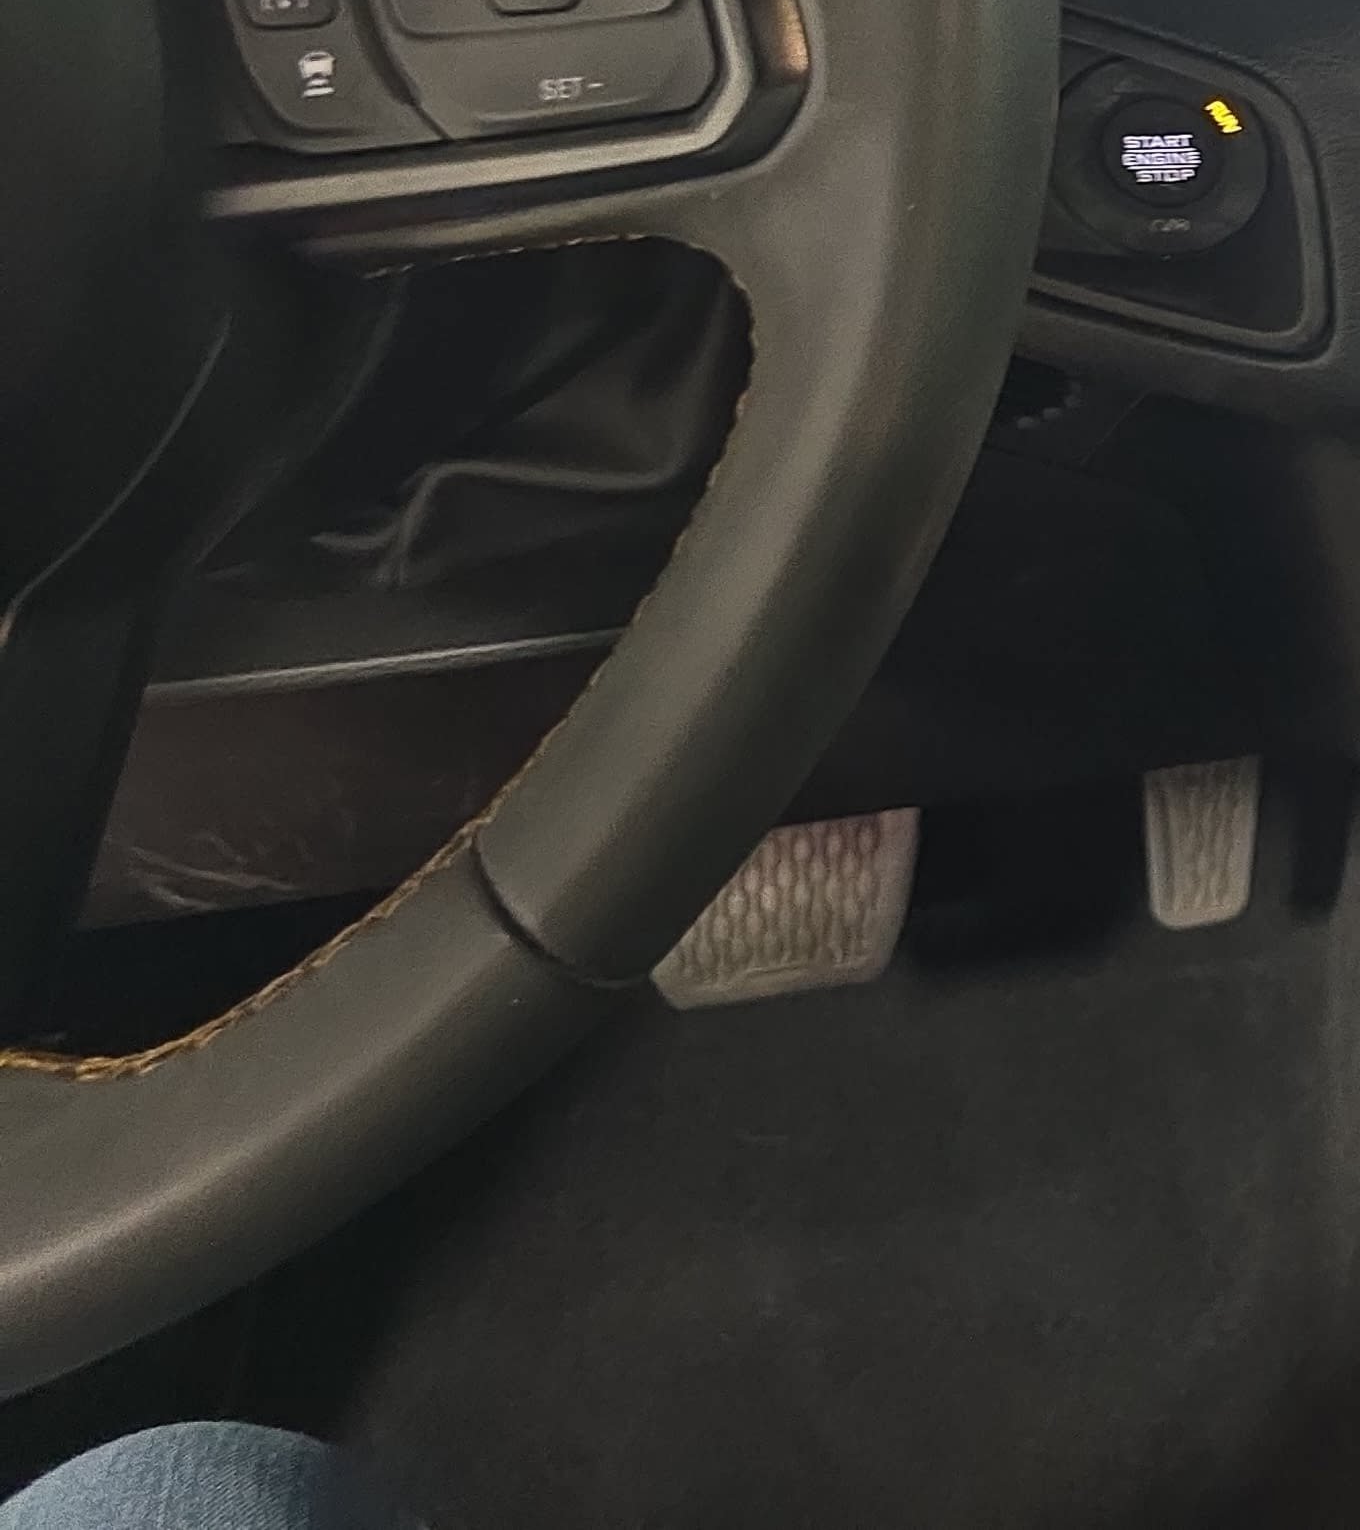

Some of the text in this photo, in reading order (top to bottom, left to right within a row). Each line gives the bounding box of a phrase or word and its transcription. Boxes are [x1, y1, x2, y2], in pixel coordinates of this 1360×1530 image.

[1122, 133, 1194, 149] START
[1121, 151, 1202, 166] ENGINE
[1135, 168, 1196, 183] STOP
